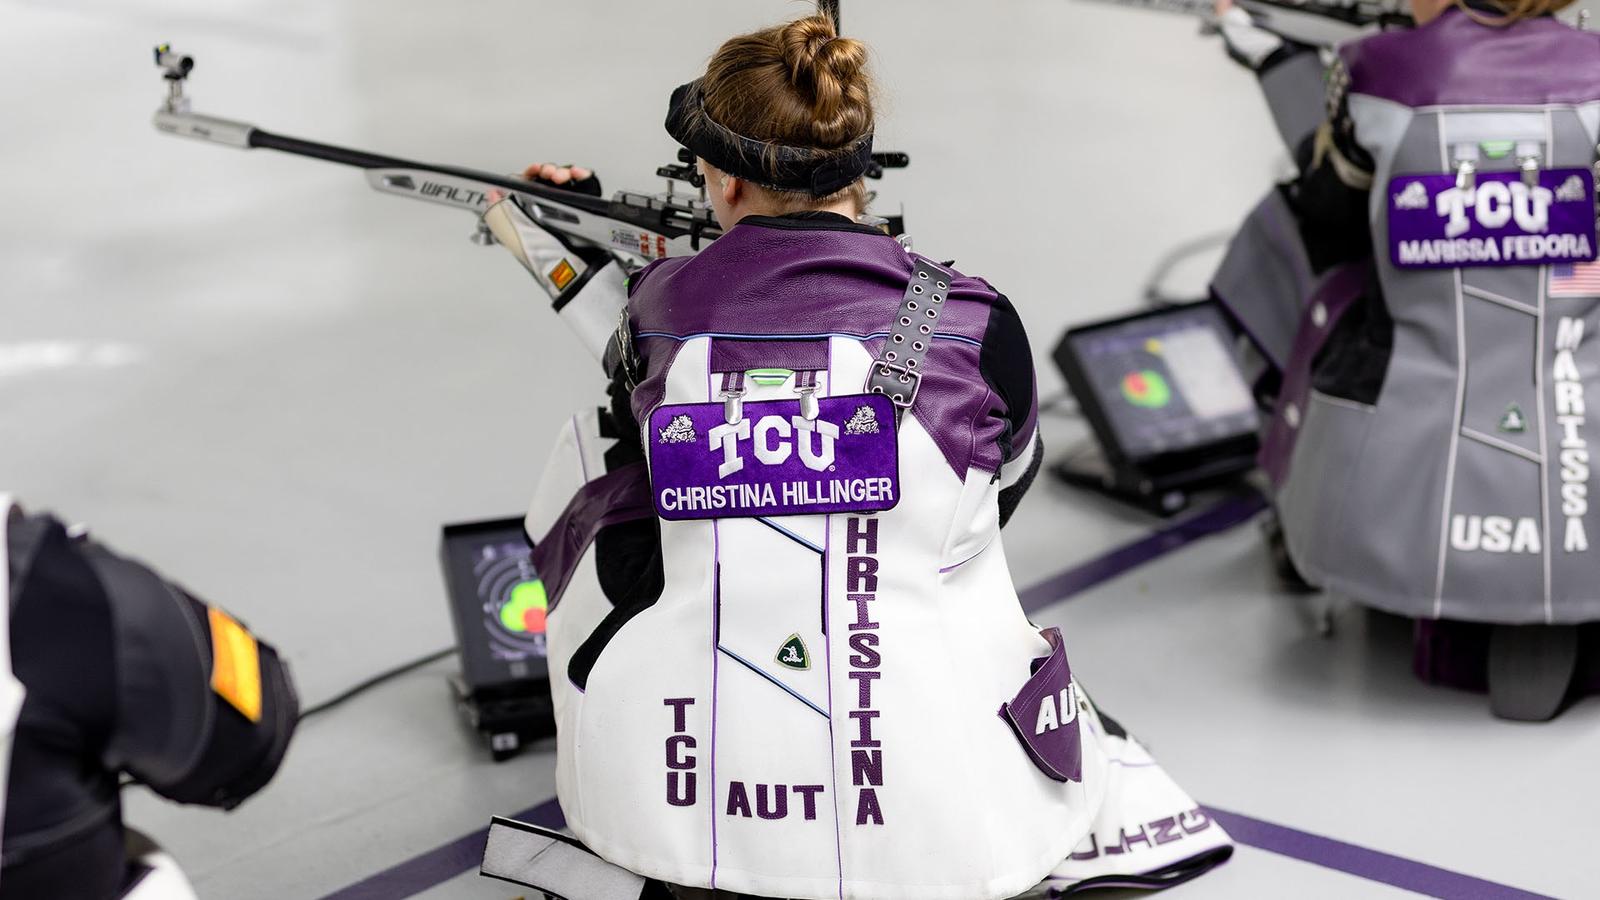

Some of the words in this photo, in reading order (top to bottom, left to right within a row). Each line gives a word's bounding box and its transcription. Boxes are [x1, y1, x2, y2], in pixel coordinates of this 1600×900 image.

[1435, 181, 1553, 238] TCU
[1399, 237, 1499, 264] MARISSA
[1502, 233, 1592, 260] FEDORA
[708, 415, 840, 479] TCU
[1553, 316, 1589, 551] MARISSA
[661, 481, 777, 511] CHRISTINA
[783, 477, 893, 506] HILLINGER
[1451, 514, 1541, 553] USA
[847, 511, 884, 825] HRISTINA
[1035, 682, 1079, 735] AU
[664, 697, 697, 806] TCU
[726, 781, 824, 820] AUT
